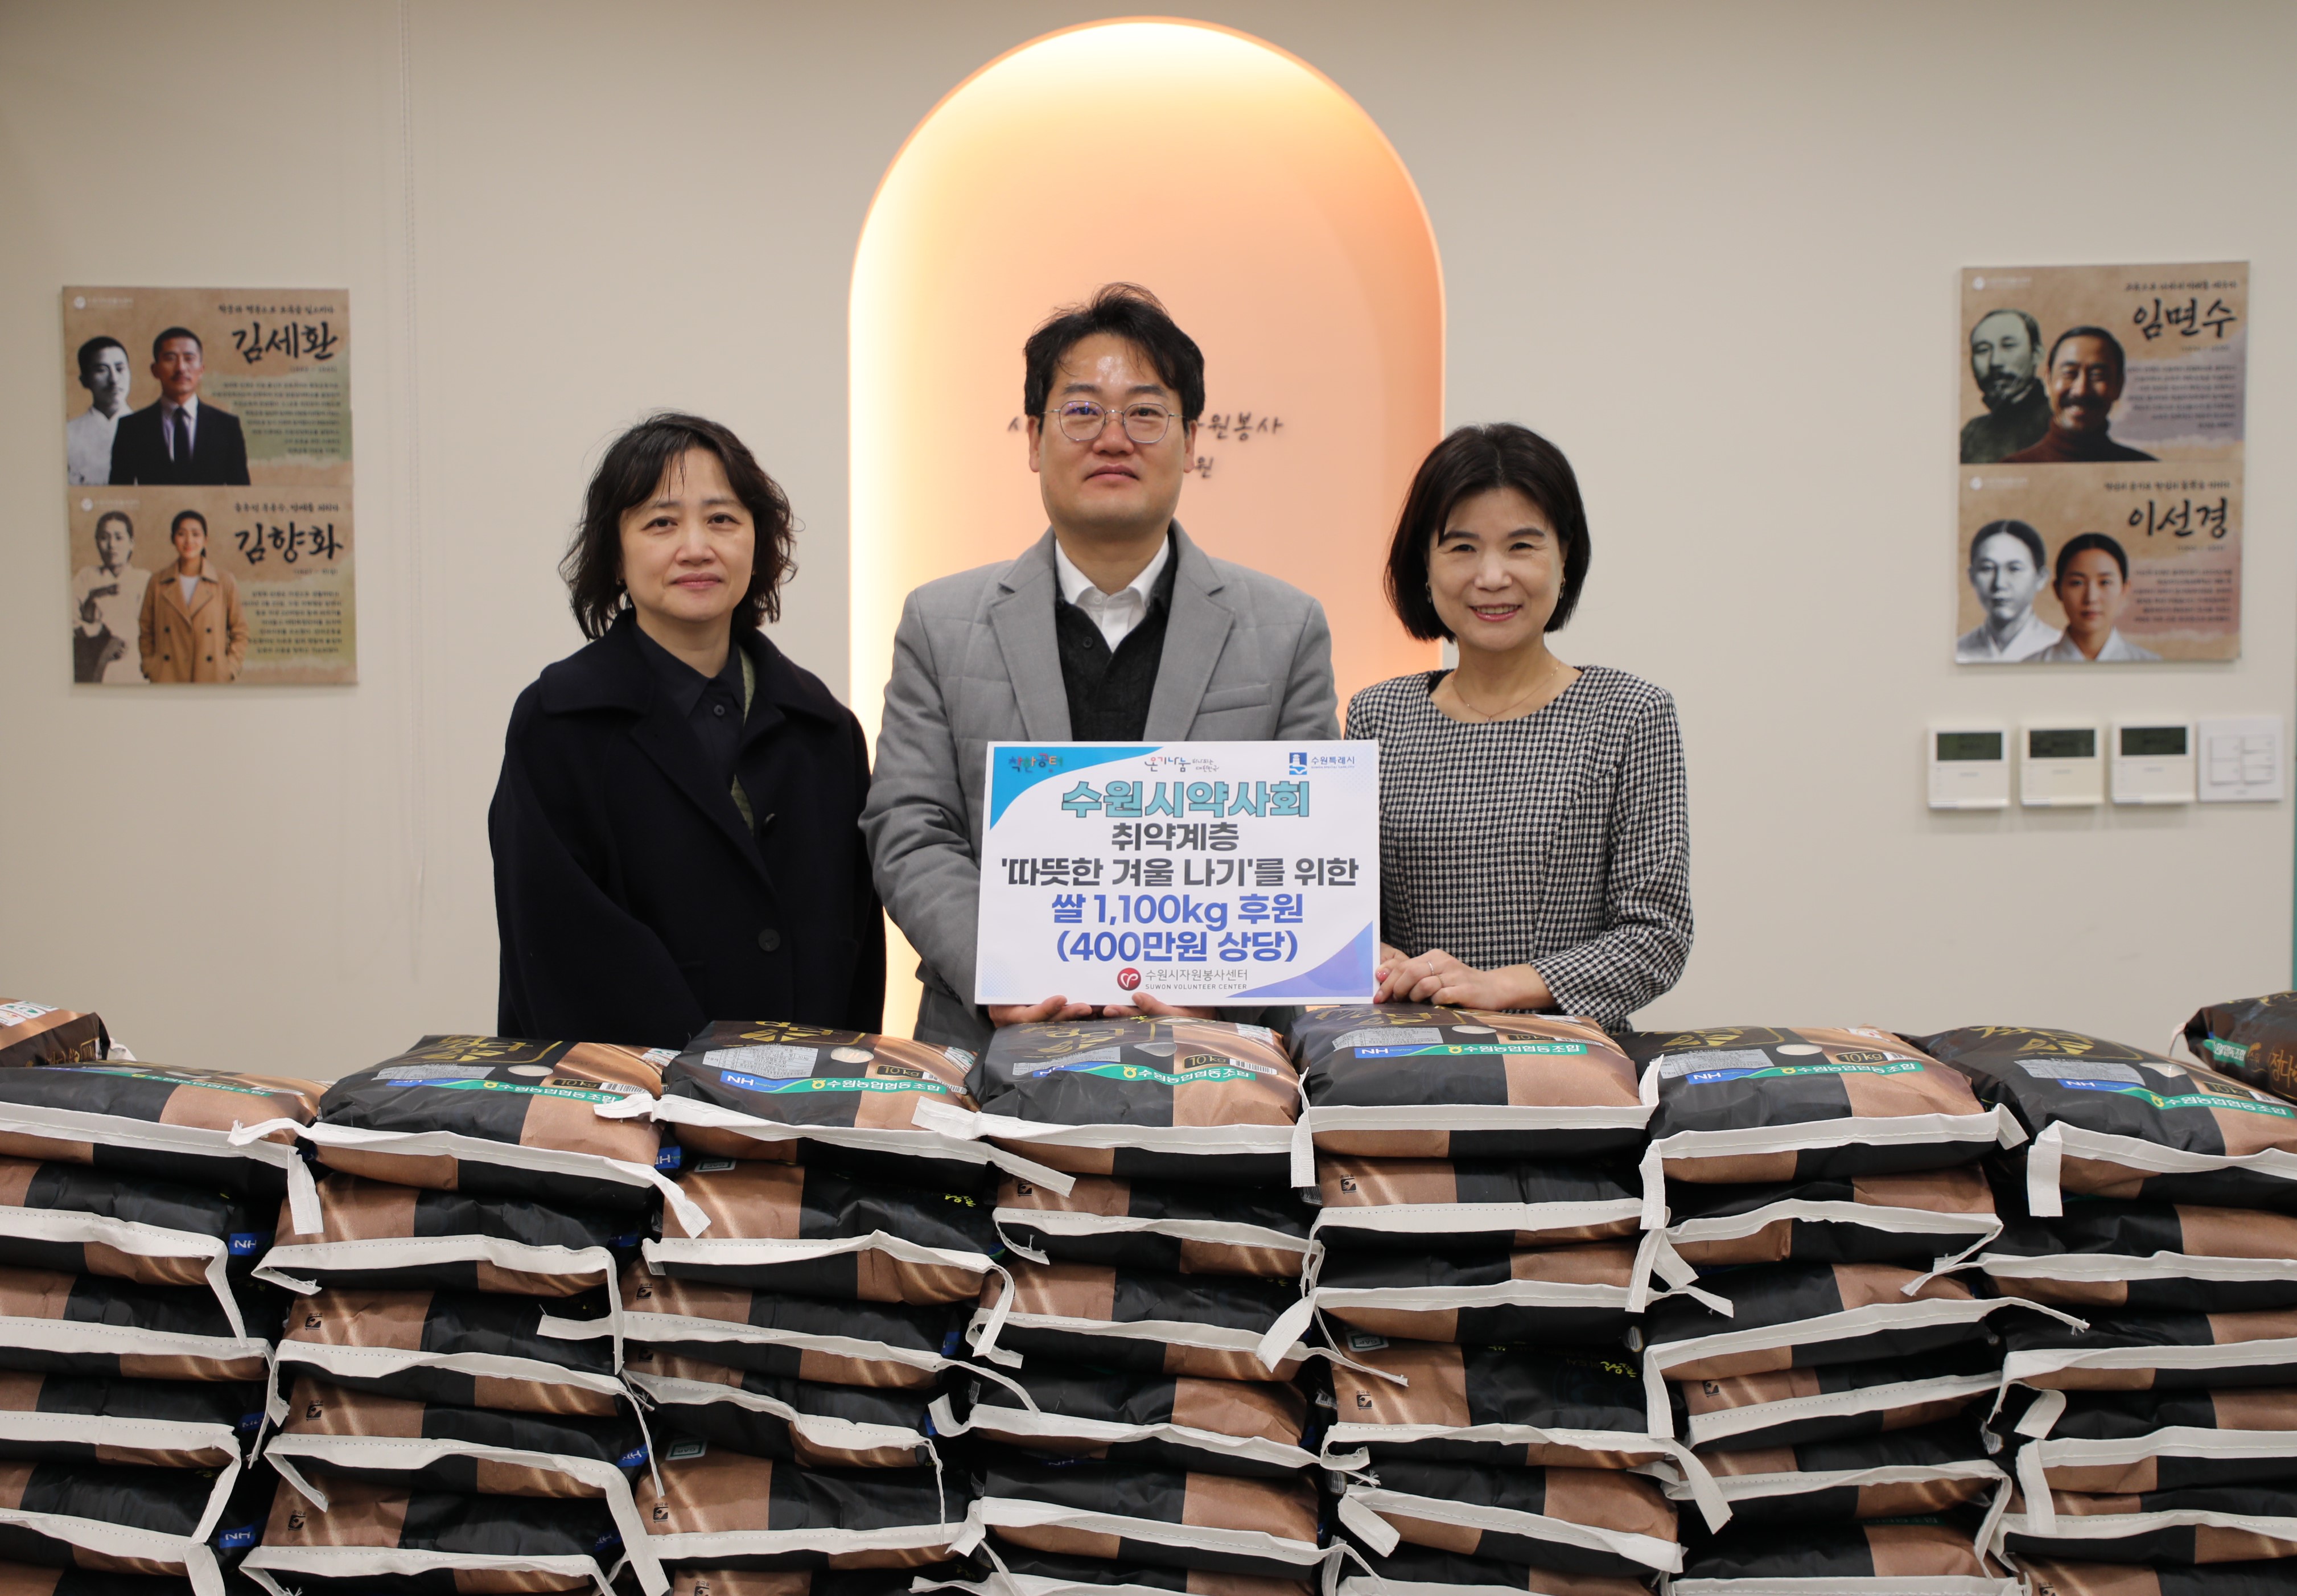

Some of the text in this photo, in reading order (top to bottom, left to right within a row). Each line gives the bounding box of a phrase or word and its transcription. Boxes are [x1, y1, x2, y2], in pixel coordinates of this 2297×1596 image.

[2134, 297, 2237, 340] 임면수
[232, 321, 338, 364] 김세환
[1197, 412, 1284, 441] 원봉사
[2129, 497, 2228, 538] 이선경
[235, 521, 343, 564] 김향화
[1145, 756, 1191, 772] 온기나눔
[1311, 756, 1355, 764] 수원특례시
[1062, 781, 1309, 817] 수원시약사회
[1112, 823, 1238, 850] 취약계층
[1002, 858, 1359, 887] '따뜻한 겨울 나기'를 위한
[1052, 893, 1303, 931] 쌀 1,100kg 후원
[1057, 930, 1298, 962] (400만원 상당)
[1145, 969, 1248, 981] 수원시자원봉사센터
[1464, 1044, 1580, 1053] 수원농업협동조합
[727, 1075, 754, 1086] NH
[827, 1080, 941, 1092] 수원농업협동조합
[1138, 1069, 1250, 1083] 수원농업협동조합
[234, 1239, 256, 1249] NH
[225, 1532, 251, 1540] NH
